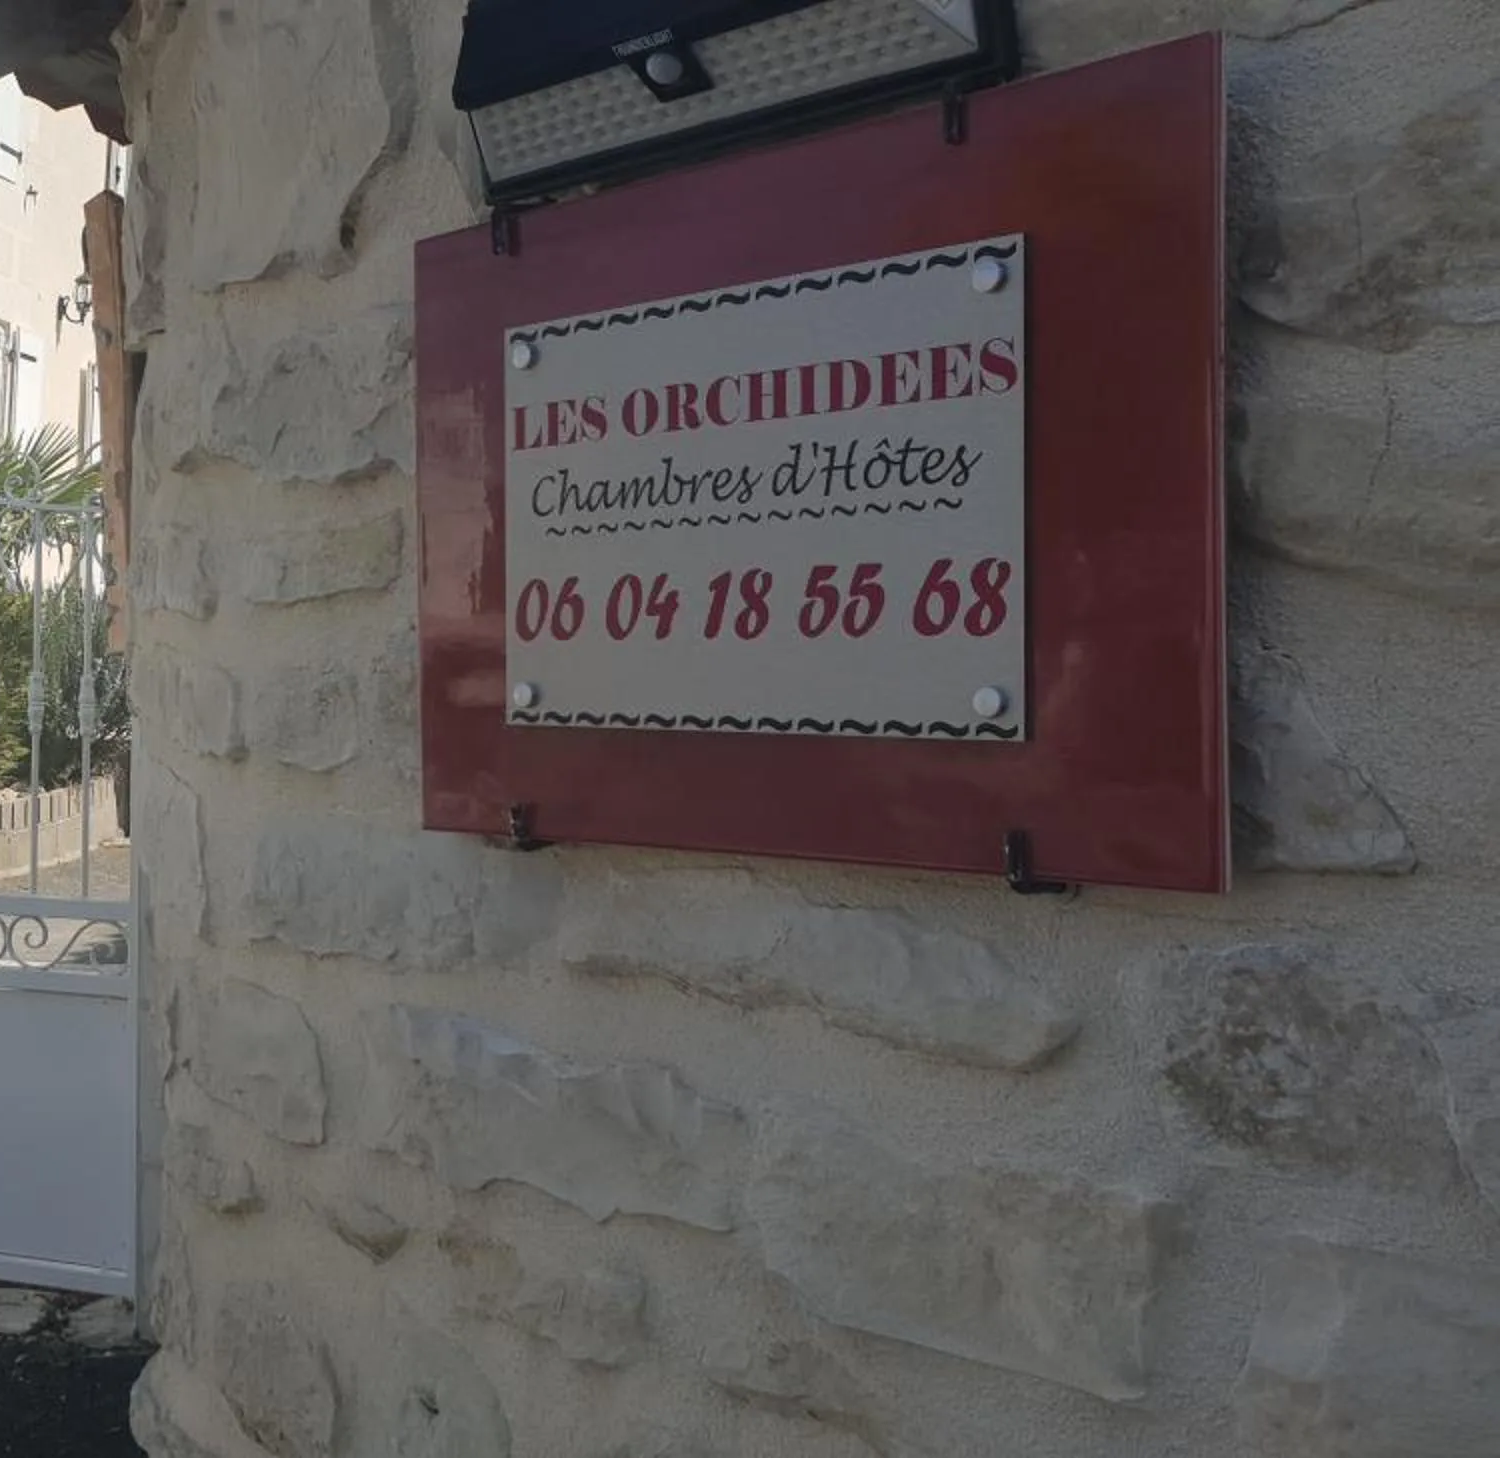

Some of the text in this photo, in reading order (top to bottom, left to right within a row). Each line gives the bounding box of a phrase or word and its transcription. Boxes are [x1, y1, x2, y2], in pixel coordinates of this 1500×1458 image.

[513, 336, 1019, 451] LES ORCHIDEES
[532, 436, 983, 518] Chambres d'Hôtes
[515, 557, 1012, 642] 06 04 18 55 68
